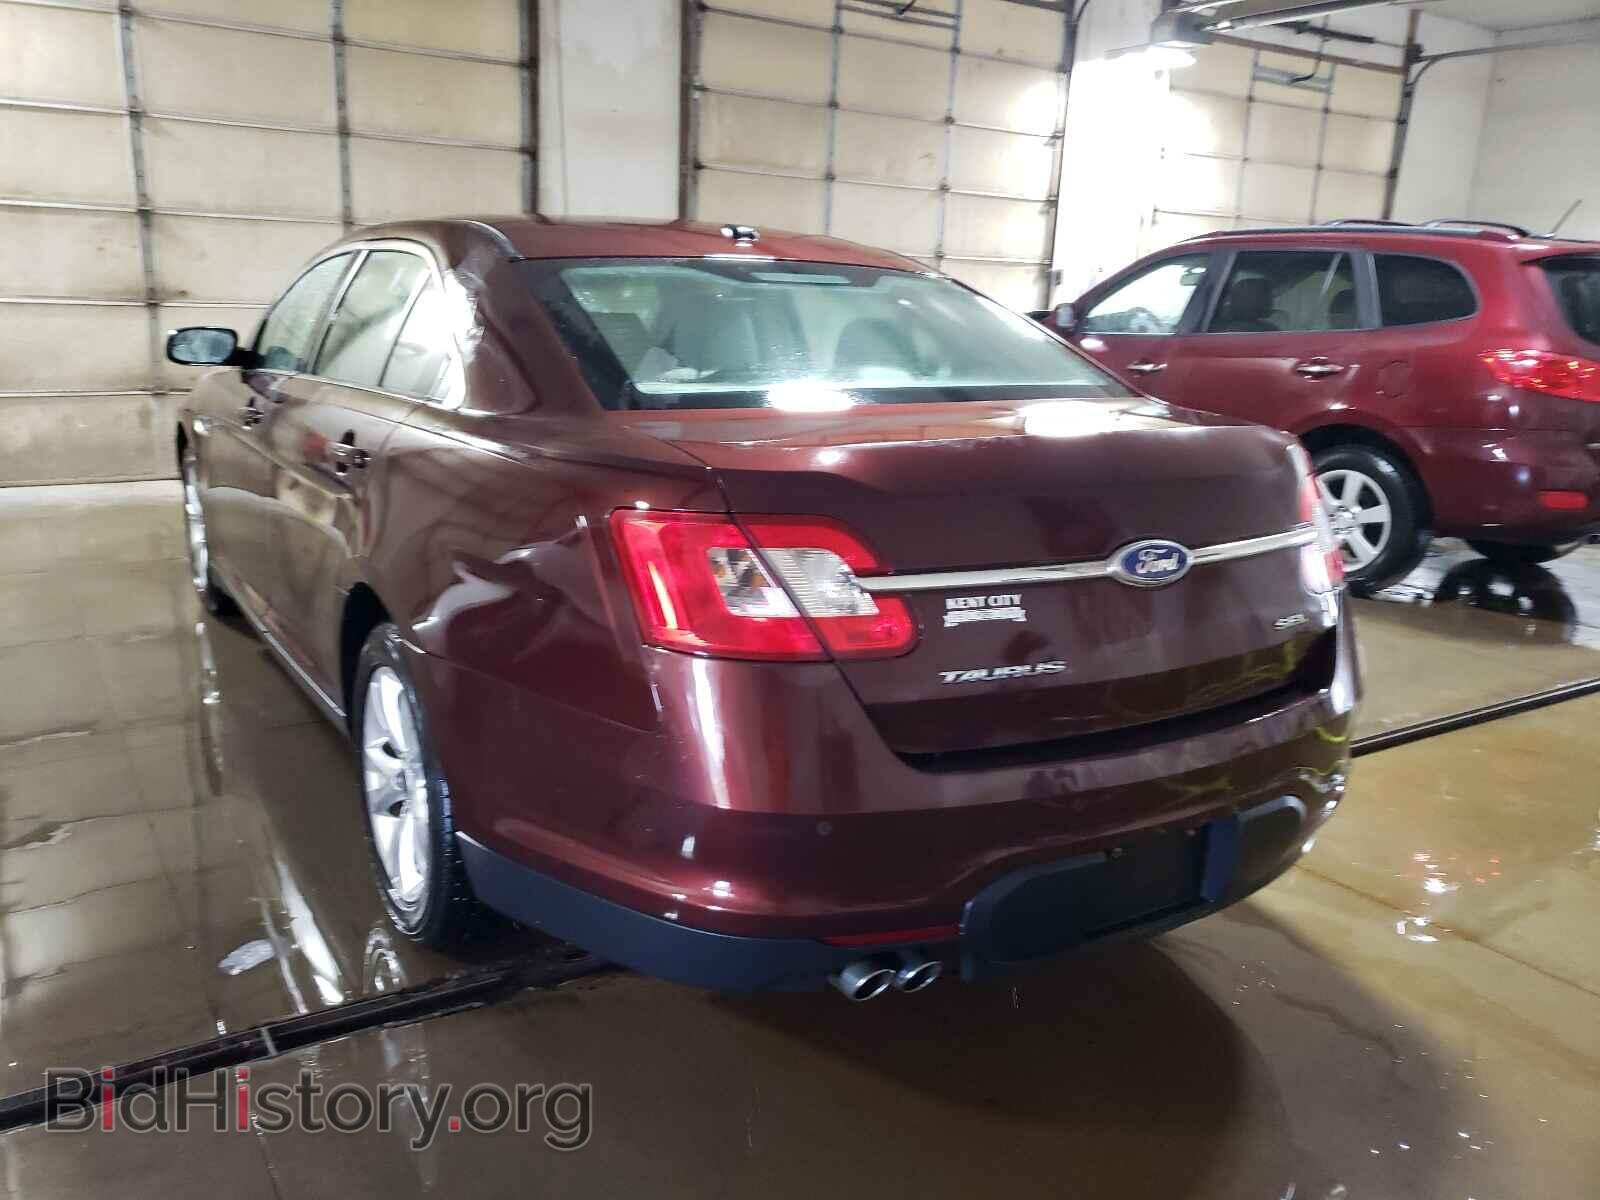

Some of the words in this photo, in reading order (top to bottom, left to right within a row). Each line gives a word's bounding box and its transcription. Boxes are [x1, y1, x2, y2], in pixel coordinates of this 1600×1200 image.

[1135, 548, 1180, 574] Ford
[945, 596, 987, 609] KENT
[987, 594, 1022, 606] CITY
[938, 660, 1068, 684] TAURUS
